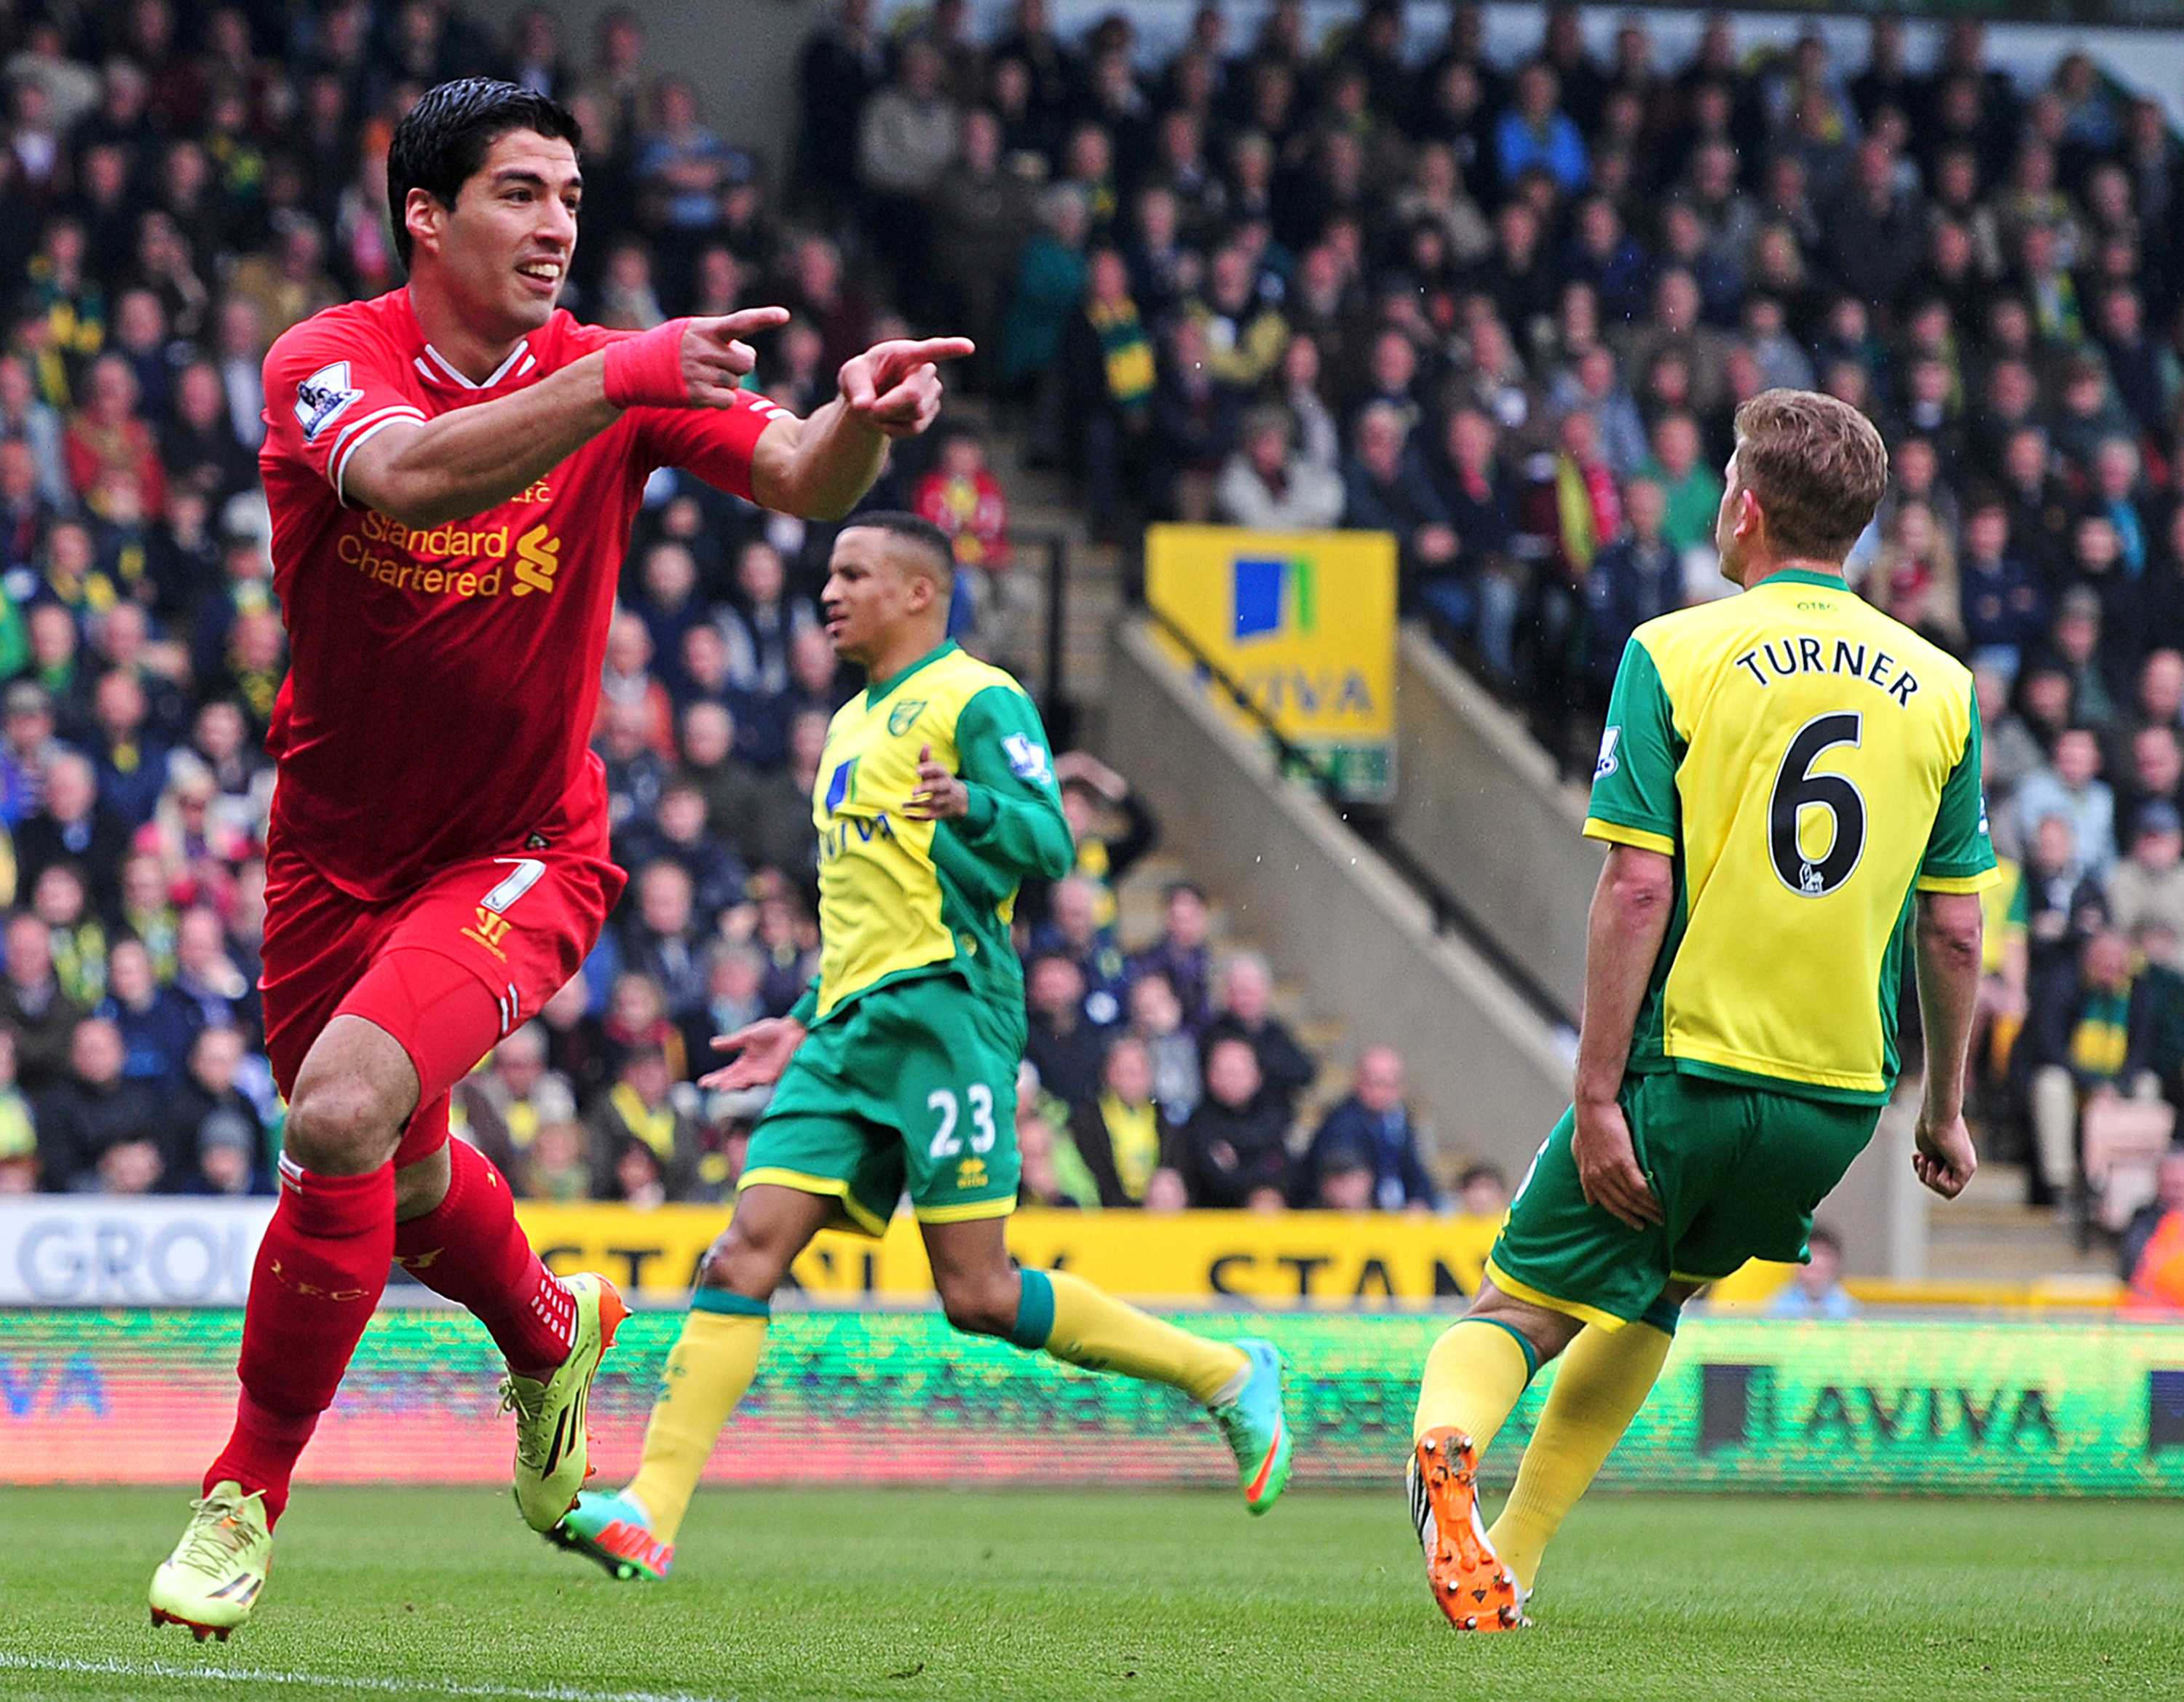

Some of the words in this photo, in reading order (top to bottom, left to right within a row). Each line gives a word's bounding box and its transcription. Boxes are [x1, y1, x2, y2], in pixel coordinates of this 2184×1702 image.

[337, 534, 502, 598] Chartered
[361, 510, 509, 558] Standard
[1736, 636, 1920, 709] TURNER
[1767, 711, 1868, 899] 6
[480, 858, 547, 915] 7
[927, 1082, 997, 1160] 23
[1805, 1385, 2060, 1452] AVIVA
